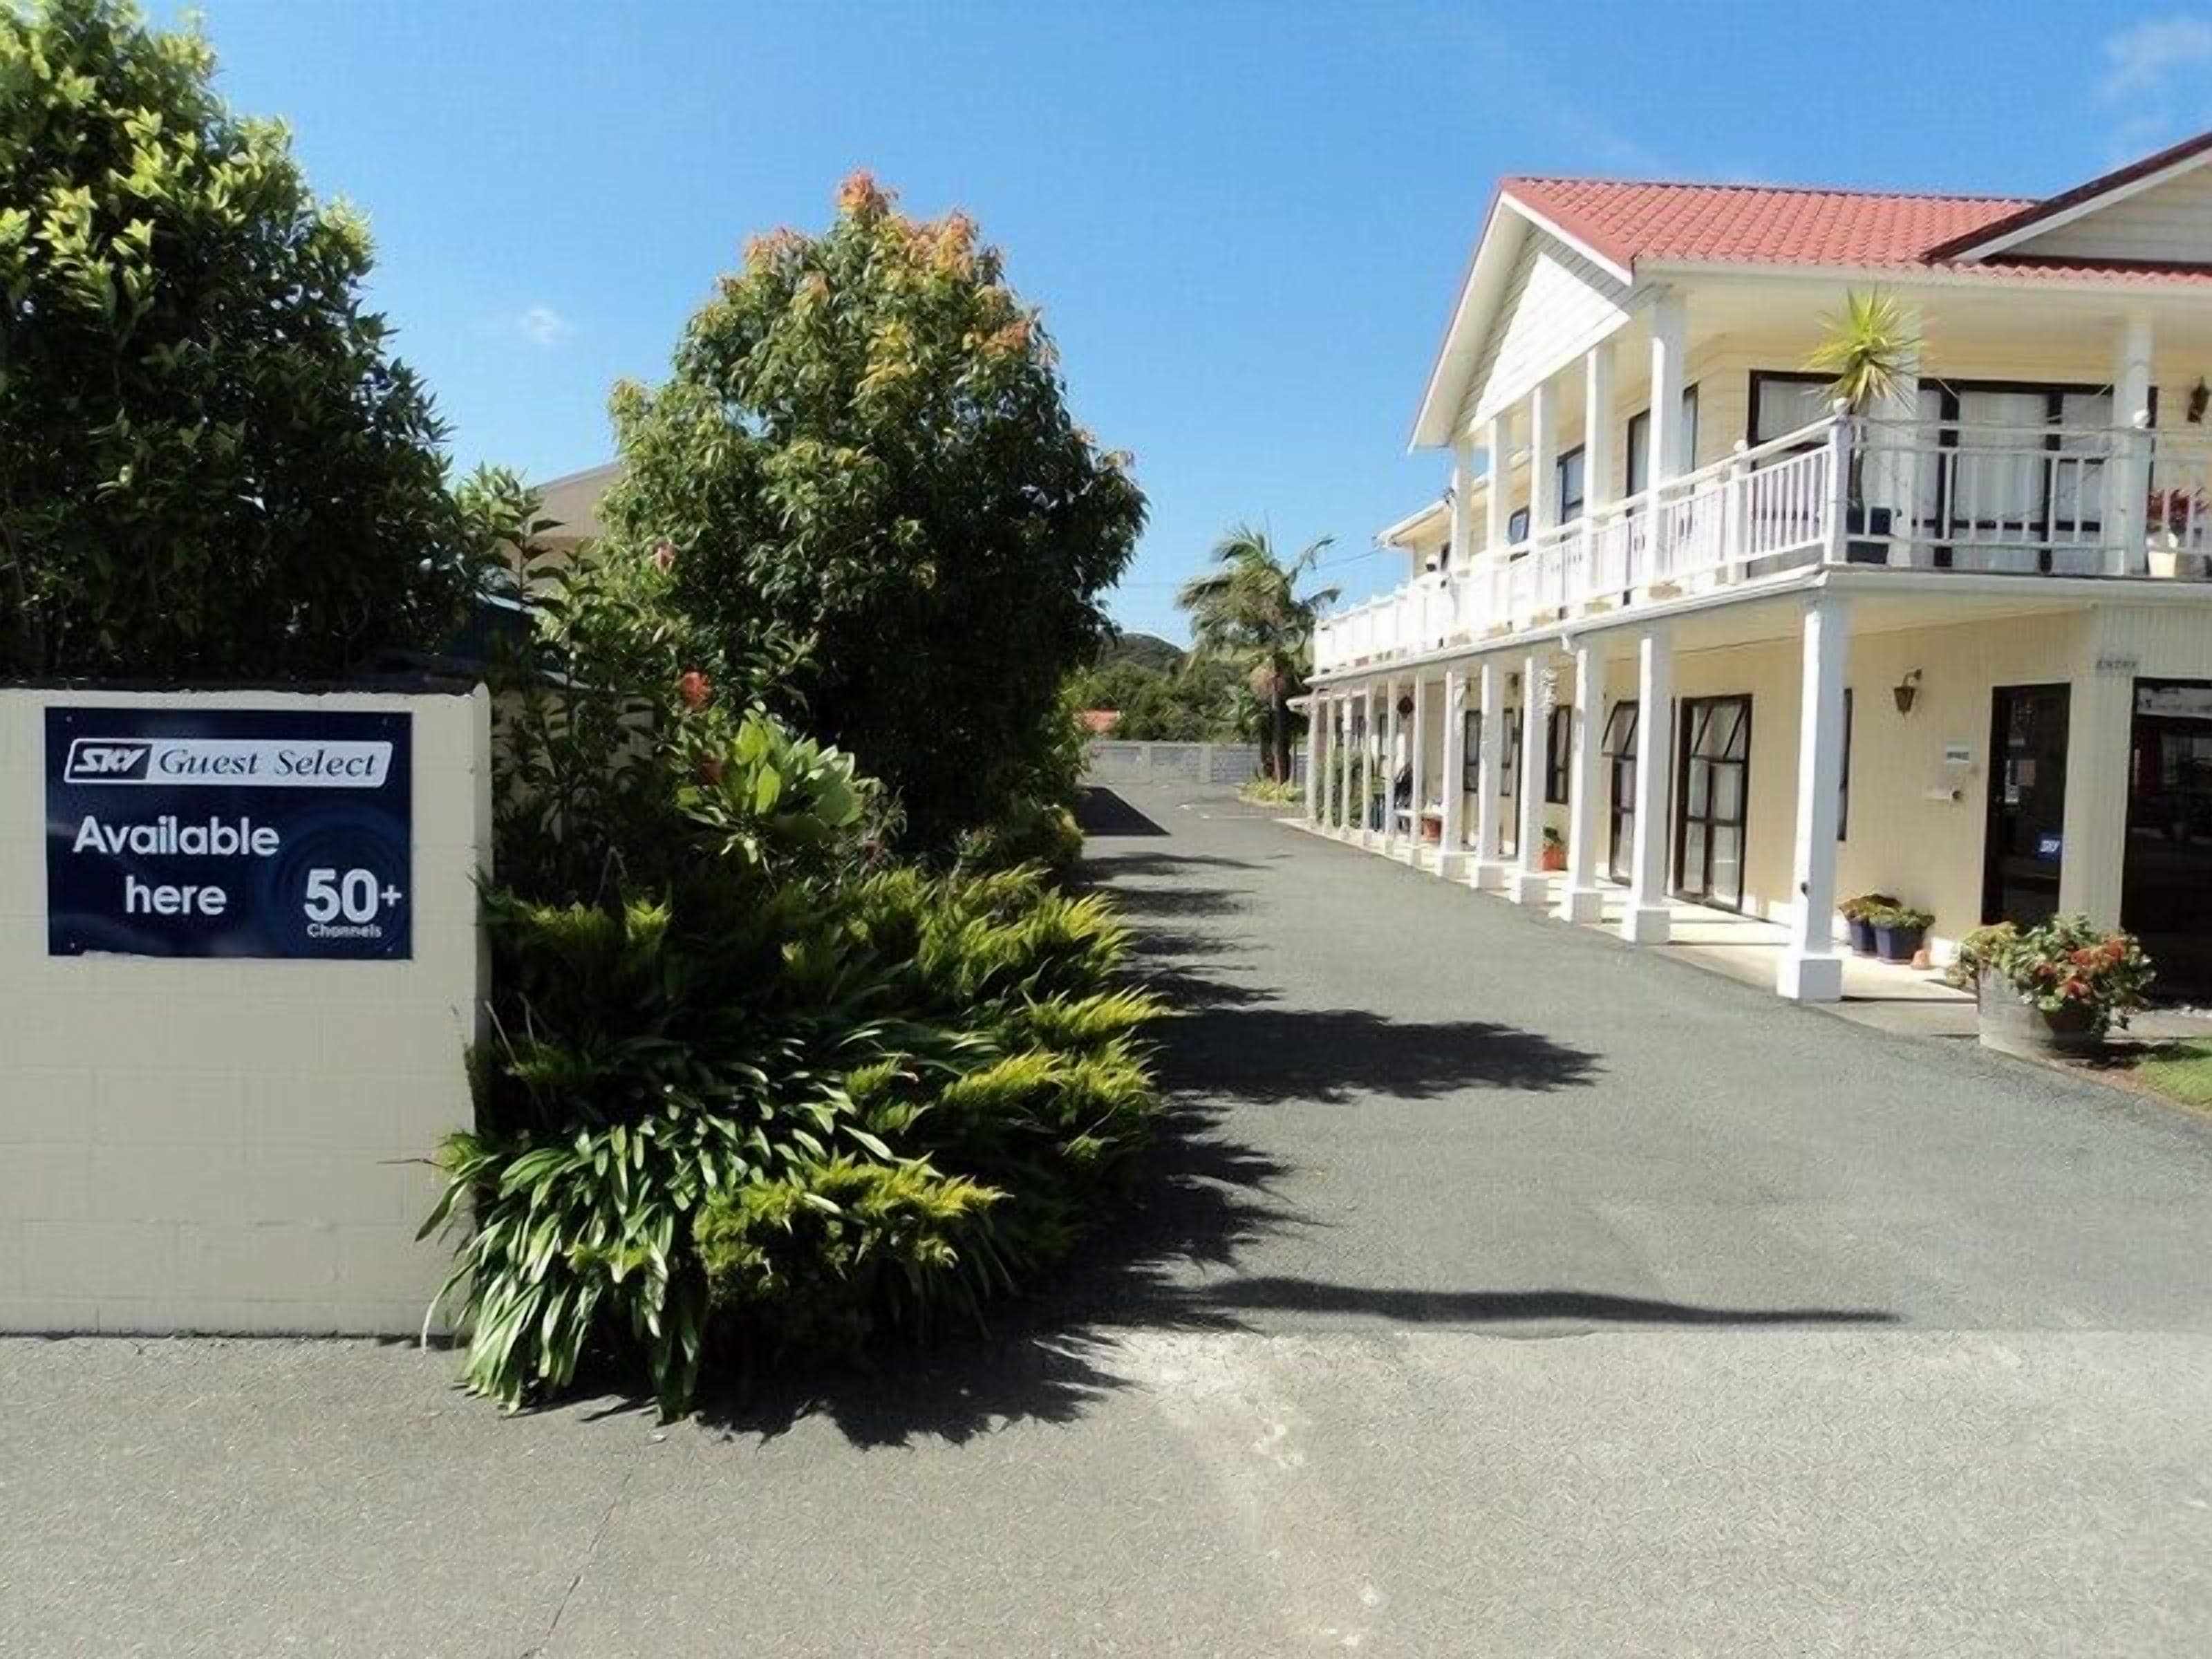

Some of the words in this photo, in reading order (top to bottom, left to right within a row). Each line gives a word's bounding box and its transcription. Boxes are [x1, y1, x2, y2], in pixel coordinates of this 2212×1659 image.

[74, 749, 146, 771] SKY
[160, 749, 258, 775] Guest
[275, 749, 375, 776] Select
[73, 816, 279, 855] Available
[126, 876, 227, 915] here
[304, 868, 402, 923] 50+
